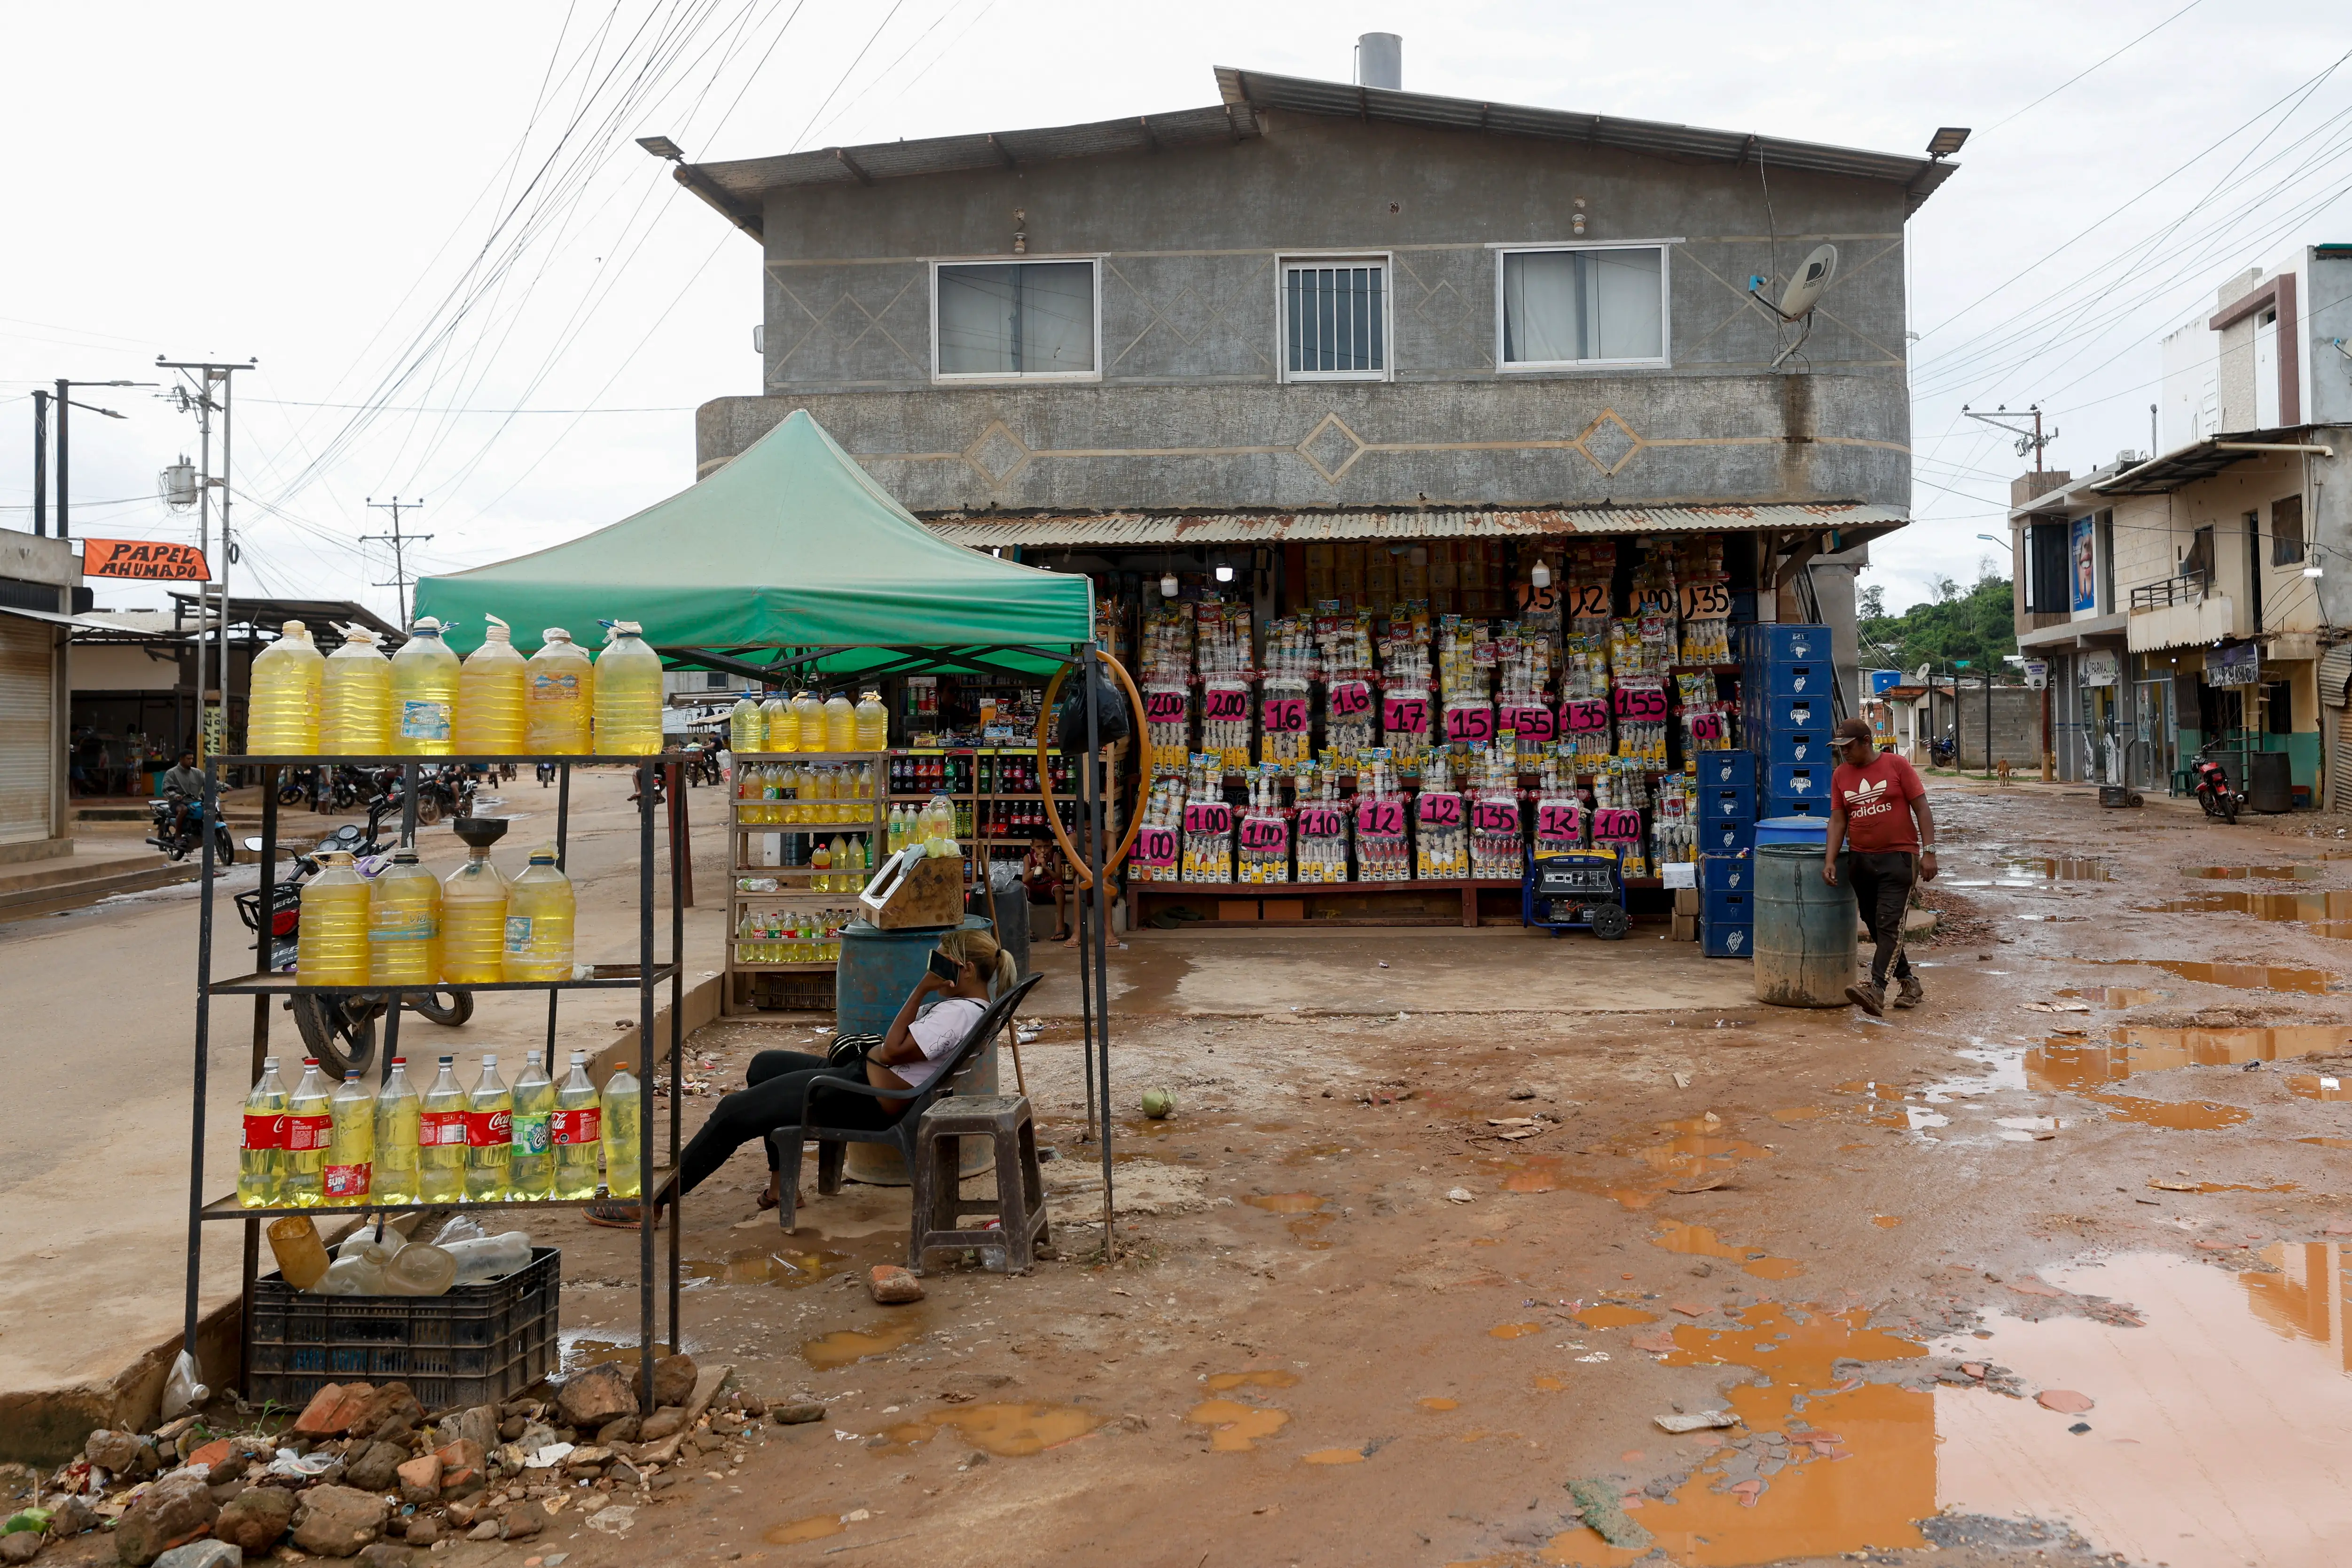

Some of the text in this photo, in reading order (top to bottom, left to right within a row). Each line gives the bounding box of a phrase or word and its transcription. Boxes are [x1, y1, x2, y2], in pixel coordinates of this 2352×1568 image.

[108, 544, 196, 564] PAPEL
[99, 563, 196, 578] AHUMADO
[1572, 586, 1606, 617] 1.2
[1685, 585, 1729, 619] 1.35
[2092, 659, 2115, 675] FARMASUR
[1333, 683, 1369, 716] 1.6
[1617, 690, 1666, 718] 1.55
[1267, 702, 1301, 732] 1.6
[1387, 703, 1425, 732] 1.7
[1451, 710, 1487, 738] 1.5
[1509, 709, 1550, 735] 1.55
[1560, 702, 1606, 732] 1.35
[1792, 710, 1809, 718] POLAR
[1791, 778, 1810, 787] POLAR
[1362, 802, 1400, 834] 1.2
[1421, 797, 1459, 823] 1.2
[1474, 802, 1515, 831] 1.35
[1541, 808, 1577, 835] 1.2
[1851, 803, 1891, 818] adidas
[1300, 812, 1340, 838] 1.10
[1595, 814, 1639, 839] 1.00
[1728, 931, 1743, 952] Light
[328, 1176, 345, 1187] SUN
